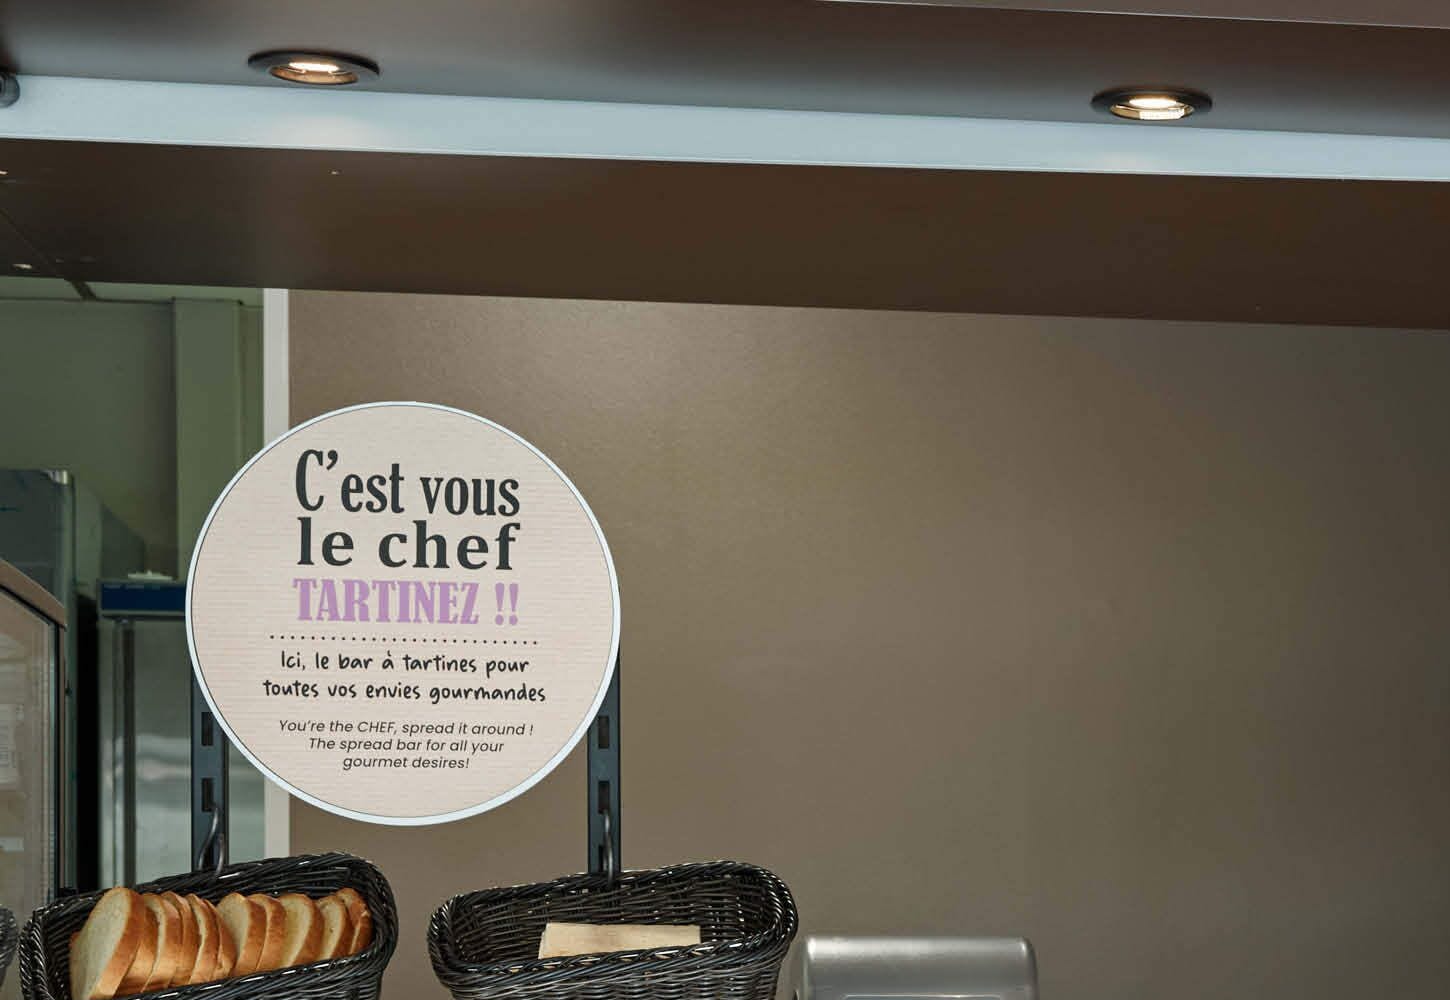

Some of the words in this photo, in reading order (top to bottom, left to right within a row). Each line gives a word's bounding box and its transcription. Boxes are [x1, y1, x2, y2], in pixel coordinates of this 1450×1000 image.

[296, 449, 405, 513] C’est
[419, 476, 520, 517] vous
[297, 517, 354, 566] le
[378, 520, 521, 570] chef
[292, 578, 480, 625] TARTINEZ
[495, 582, 519, 626] !!
[281, 650, 305, 671] Ici,
[315, 651, 329, 670] le
[338, 653, 373, 670] bar
[382, 650, 394, 670] à
[402, 654, 477, 673] tartines
[486, 659, 529, 679] pour
[263, 680, 319, 698] toutes
[327, 684, 357, 698] vos
[366, 682, 421, 700] envies
[429, 682, 546, 704] gourmandes
[280, 719, 326, 732] You’re
[329, 720, 354, 733] the
[357, 721, 397, 735] CHEF,
[402, 722, 454, 737] spread
[458, 723, 468, 735] it
[471, 724, 526, 736] around
[309, 738, 336, 750] The
[339, 739, 393, 753] spread
[396, 739, 422, 751] bar
[426, 739, 446, 752] for
[449, 740, 468, 752] all
[471, 742, 504, 755] your
[342, 758, 408, 771] gourmet
[411, 757, 470, 769] desires!
